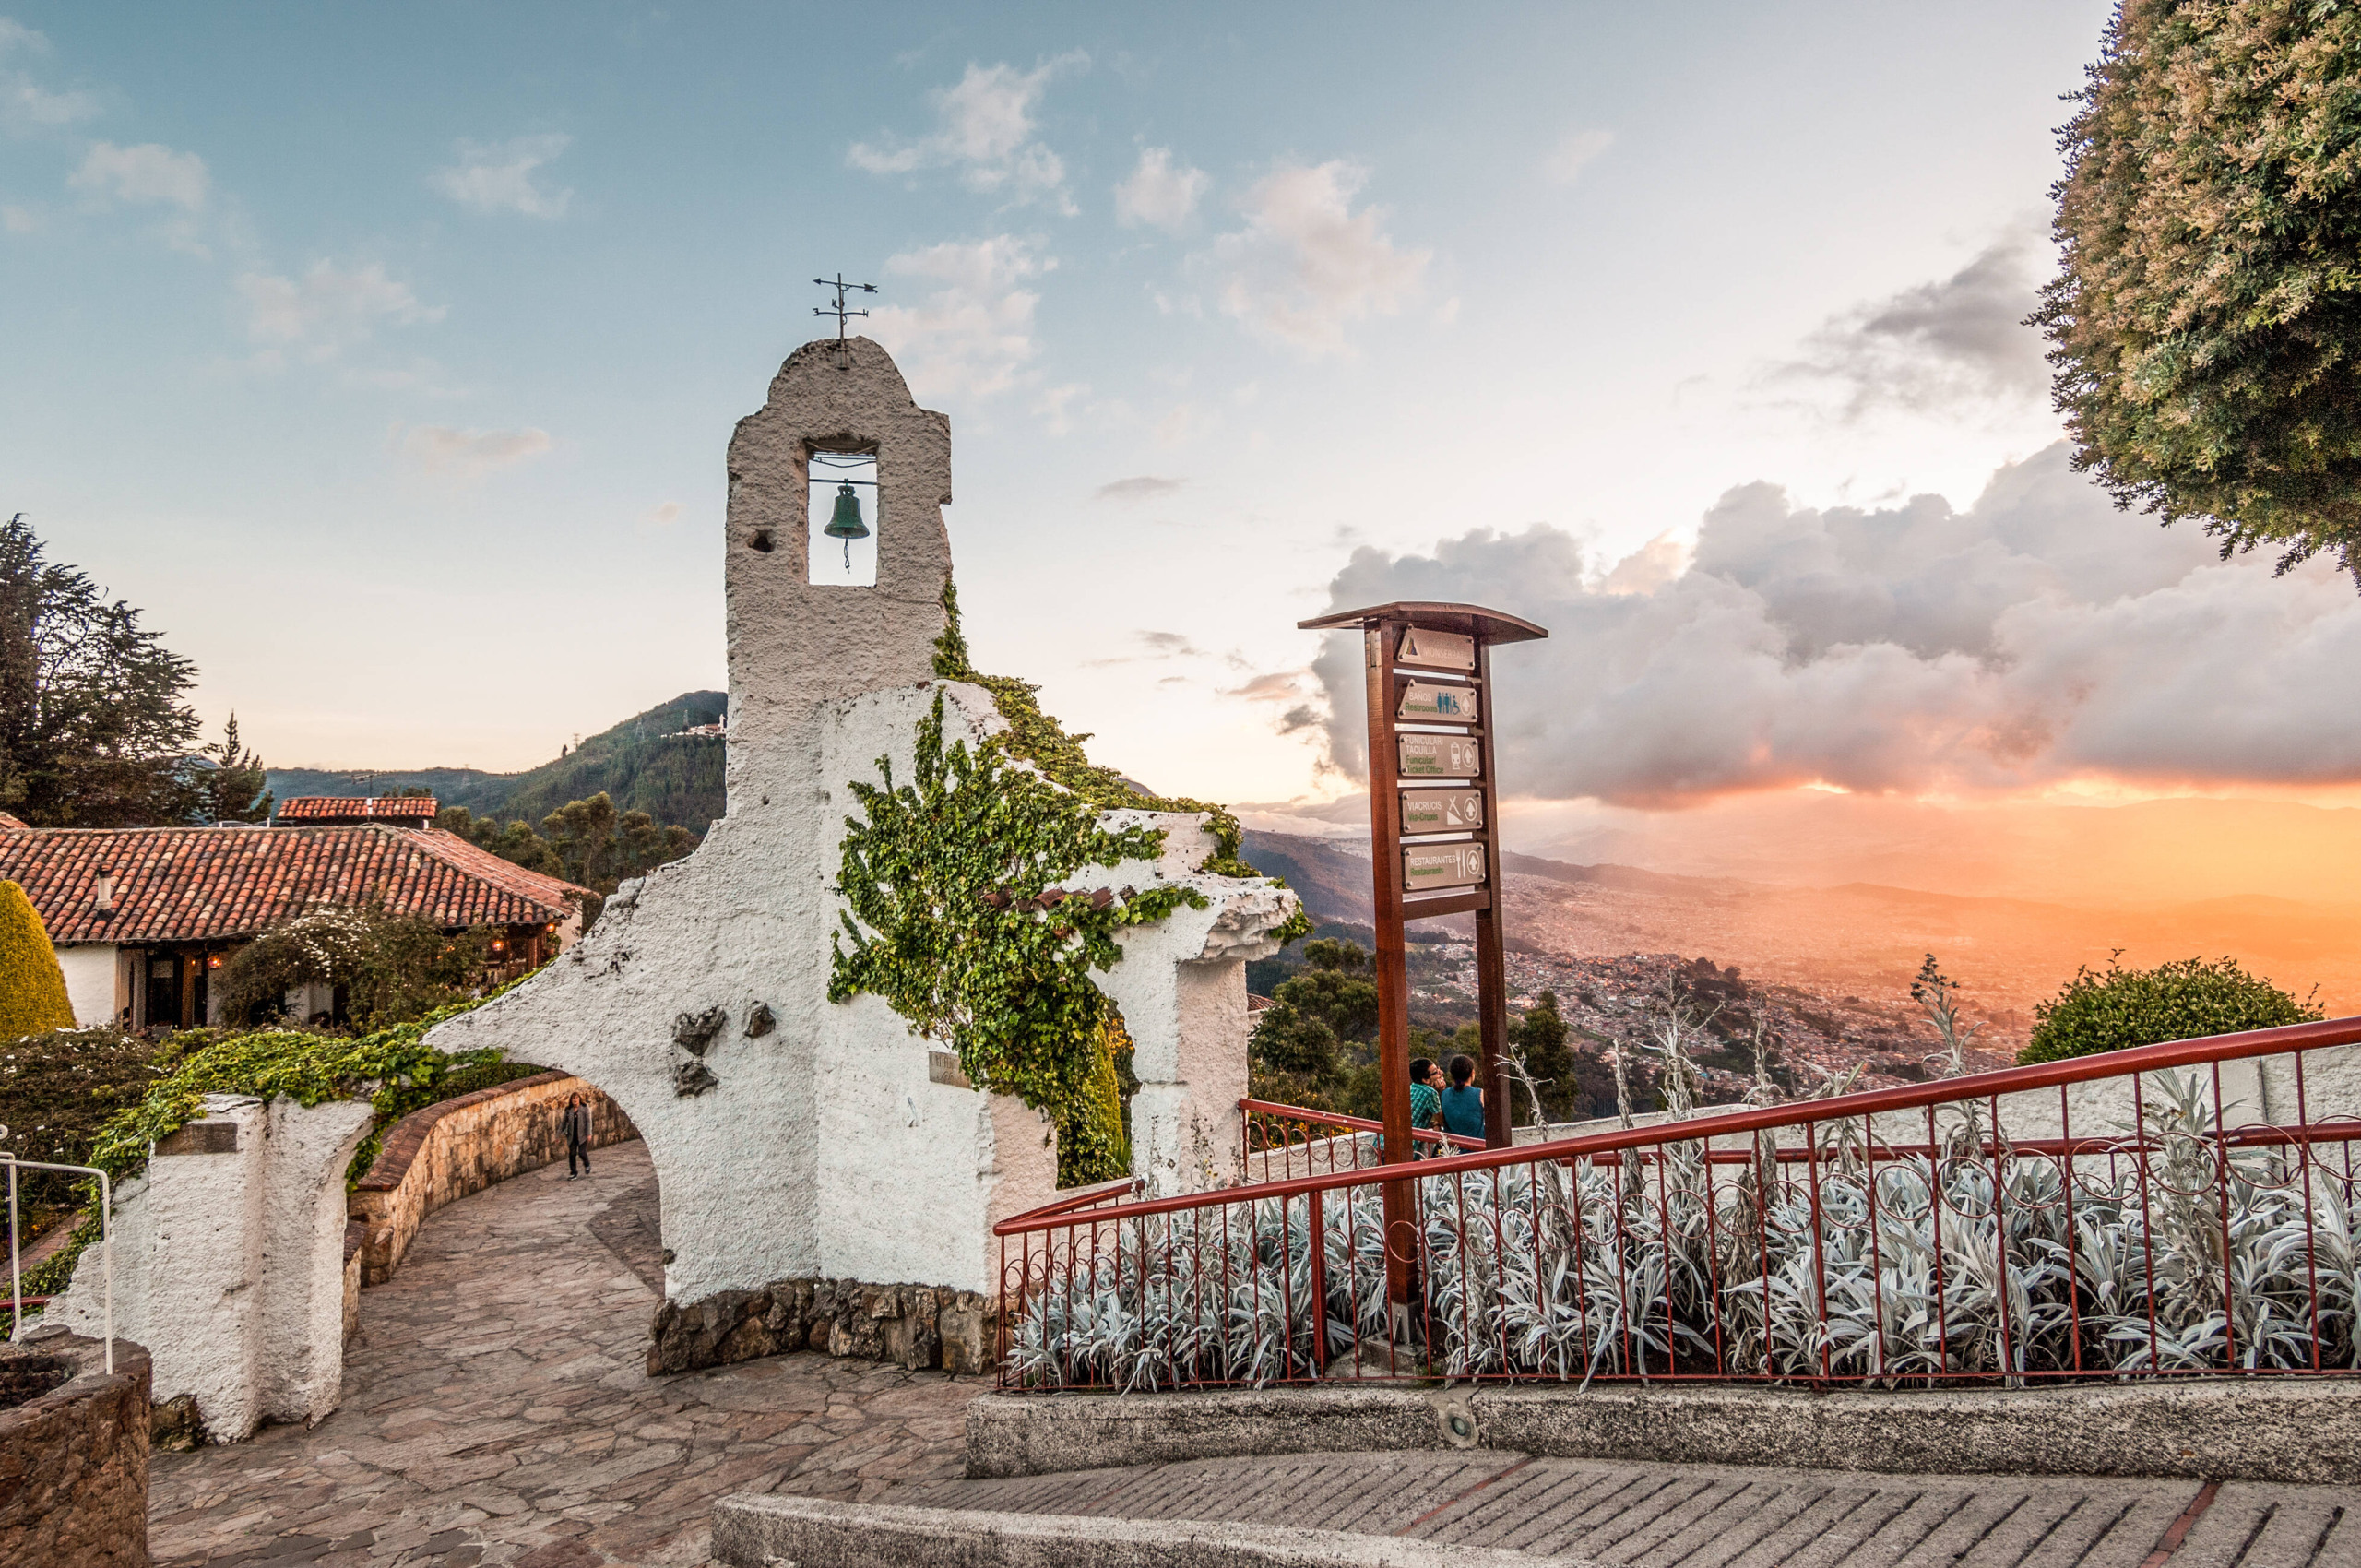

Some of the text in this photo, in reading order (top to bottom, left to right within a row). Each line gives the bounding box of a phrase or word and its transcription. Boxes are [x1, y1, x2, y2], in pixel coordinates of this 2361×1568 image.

[1409, 691, 1432, 702] BAÑOS
[1405, 702, 1438, 713] Restrooms
[1406, 744, 1437, 755] TAQUILLA
[1406, 765, 1444, 775] Ticket Office
[1407, 802, 1442, 811] VIACRUCIS
[1410, 855, 1455, 866] RESTAURANTES
